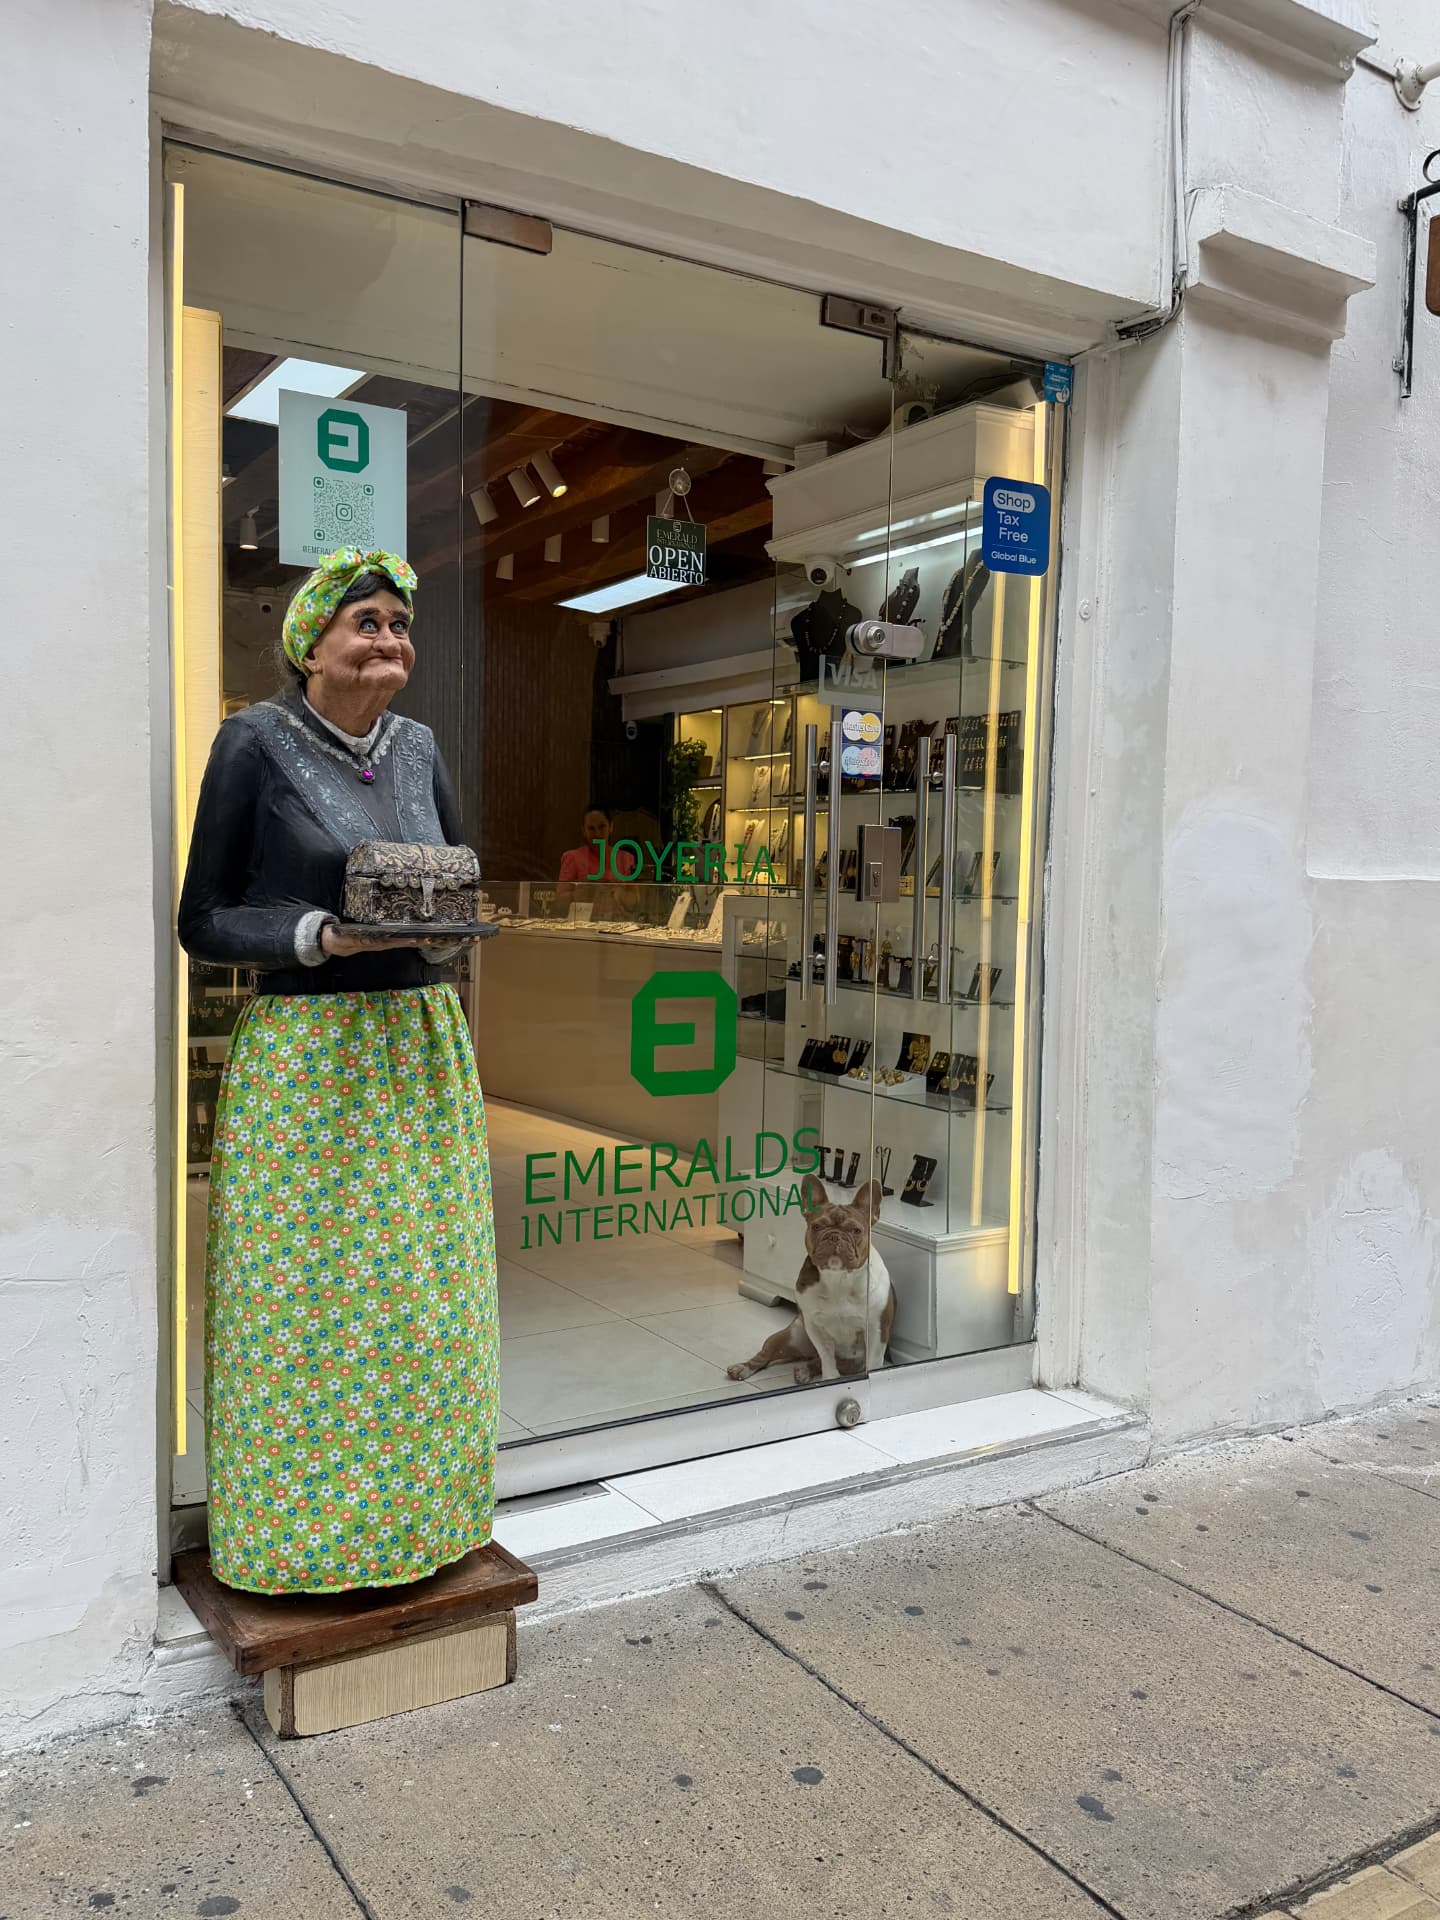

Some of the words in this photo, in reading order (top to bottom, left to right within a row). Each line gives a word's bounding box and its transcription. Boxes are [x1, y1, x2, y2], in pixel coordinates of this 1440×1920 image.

[996, 493, 1031, 511] Shop
[996, 511, 1020, 526] Tax
[999, 527, 1028, 543] Free
[649, 545, 704, 572] OPEN
[991, 550, 1018, 562] Global
[1018, 554, 1037, 564] Blue
[649, 565, 704, 585] ABIERTO
[826, 662, 878, 689] VISA
[587, 838, 777, 884] JOYERIA
[525, 1127, 821, 1205] EMERALDS
[520, 1182, 822, 1250] INTERNATIONAL
